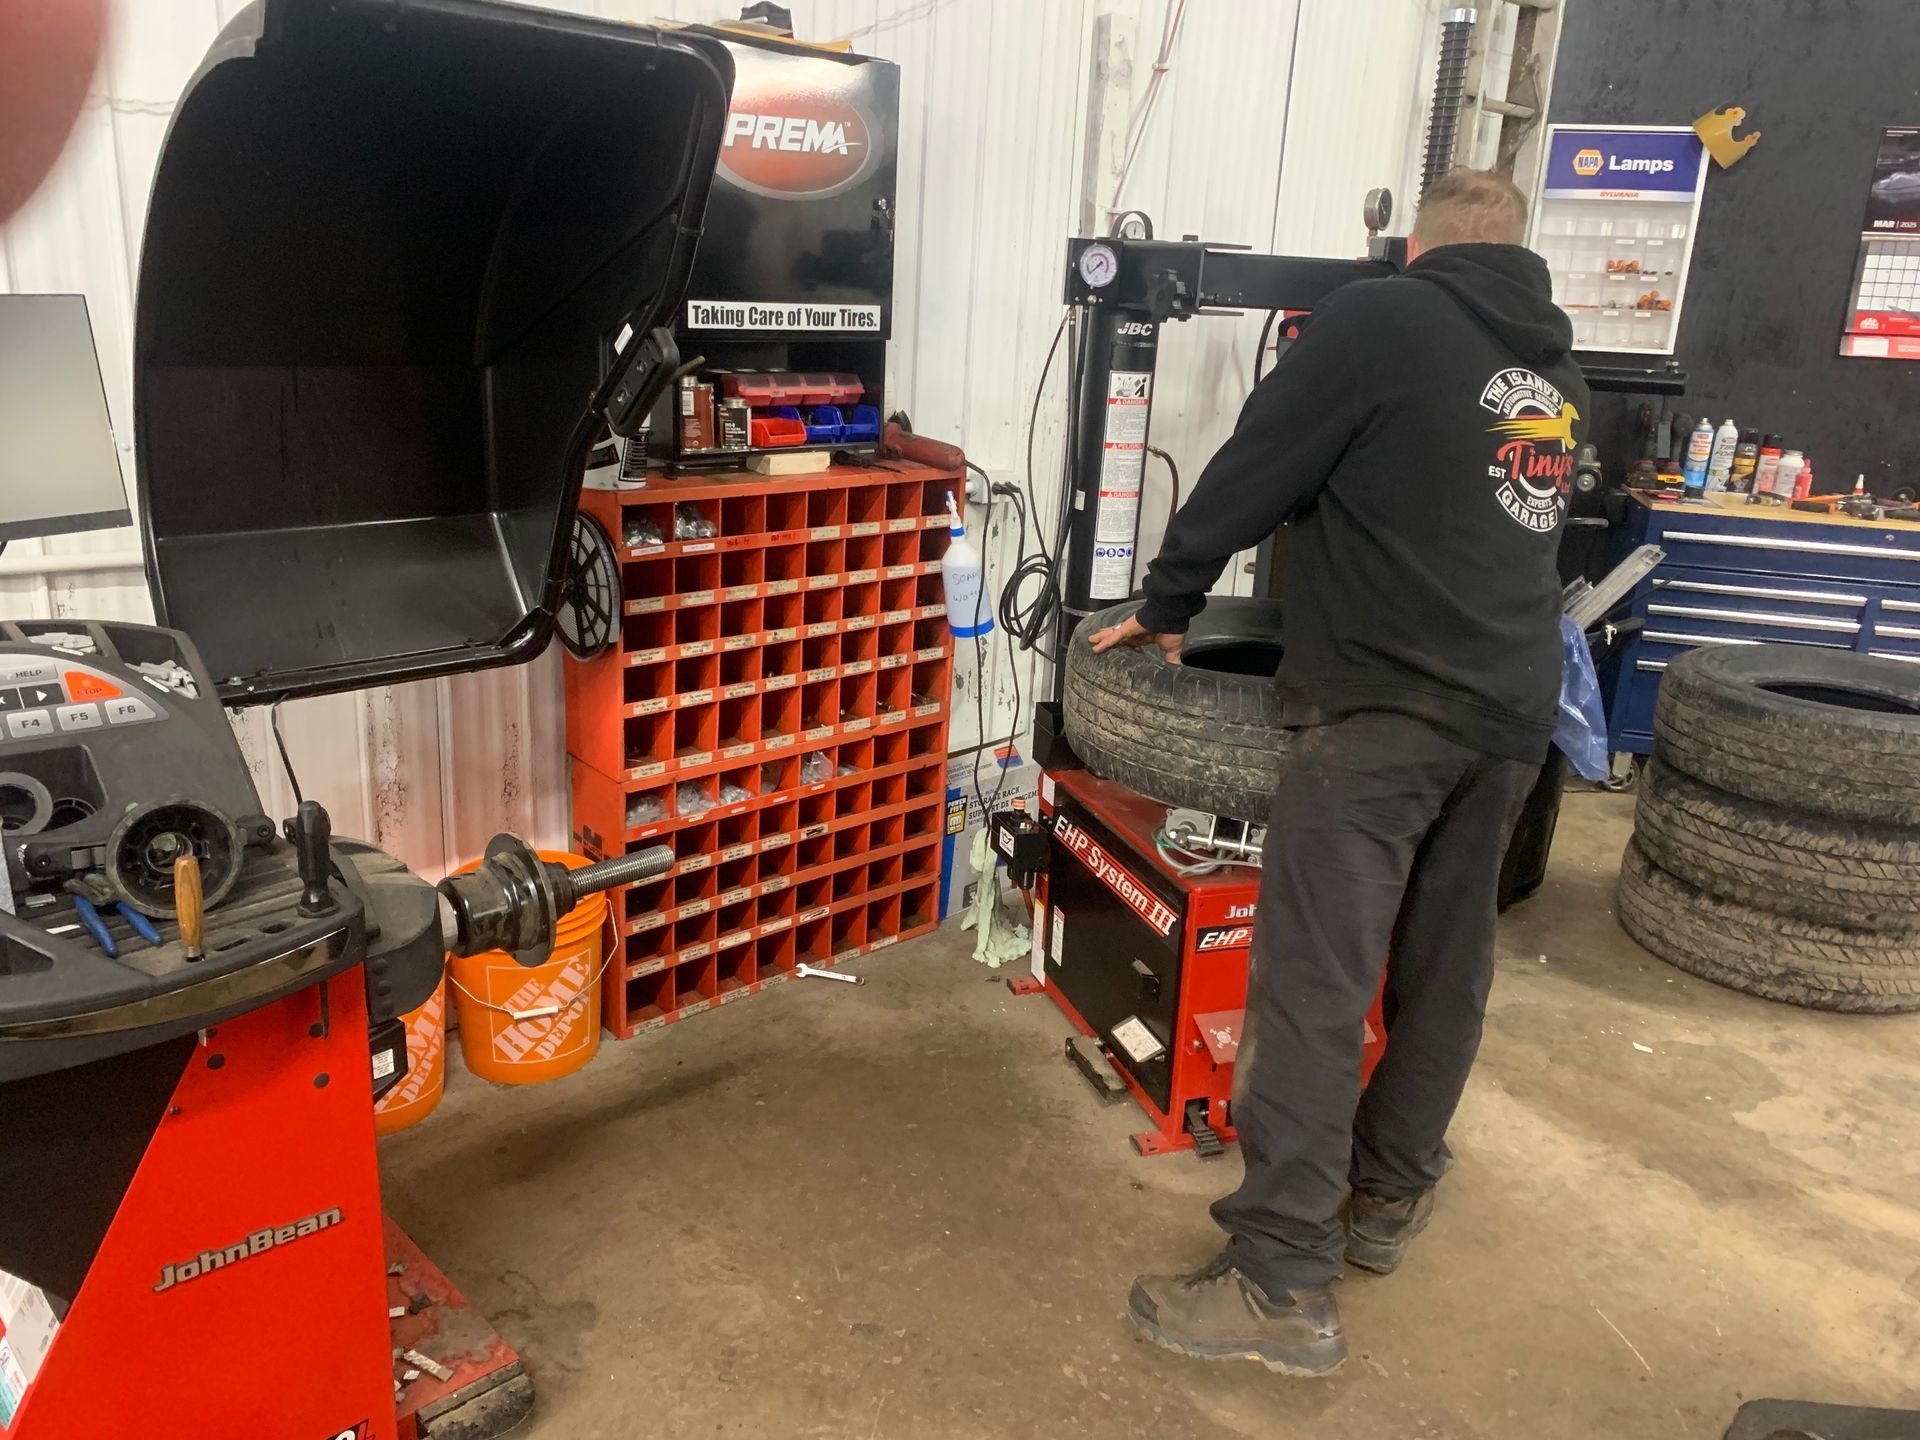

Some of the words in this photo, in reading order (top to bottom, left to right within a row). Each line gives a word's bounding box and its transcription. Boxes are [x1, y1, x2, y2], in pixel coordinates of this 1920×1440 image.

[724, 113, 850, 155] PREMA
[1578, 156, 1599, 169] NAPA
[1609, 155, 1674, 174] Lamps
[1873, 220, 1896, 228] MAR
[692, 305, 745, 327] Taking
[748, 306, 784, 326] Care
[787, 308, 802, 326] of
[805, 308, 837, 327] Your
[840, 309, 877, 327] Tires.
[1117, 322, 1153, 336] JBC
[1486, 378, 1509, 403] THE
[1506, 371, 1559, 403] ISLAND'S
[1502, 389, 1534, 415] AUTOMOTIVE
[1534, 392, 1559, 415] SERVICE
[1488, 465, 1507, 479] EST
[1501, 490, 1556, 529] GARAGE
[1526, 495, 1553, 509] EXPERTS
[15, 669, 43, 678] HELP
[77, 687, 102, 696] STOP
[70, 712, 89, 722] F5
[118, 705, 136, 715] F6
[21, 719, 41, 729] F4
[1002, 786, 1021, 799] RACK
[1001, 800, 1009, 808] DE
[1054, 815, 1089, 851] EHP
[1088, 846, 1149, 912] System
[1147, 900, 1177, 936] III
[1199, 929, 1249, 949] EHP
[501, 977, 546, 1015] THE
[494, 956, 590, 1062] HOME
[534, 992, 589, 1059] DEPOT
[153, 1207, 342, 1293] JohnBean
